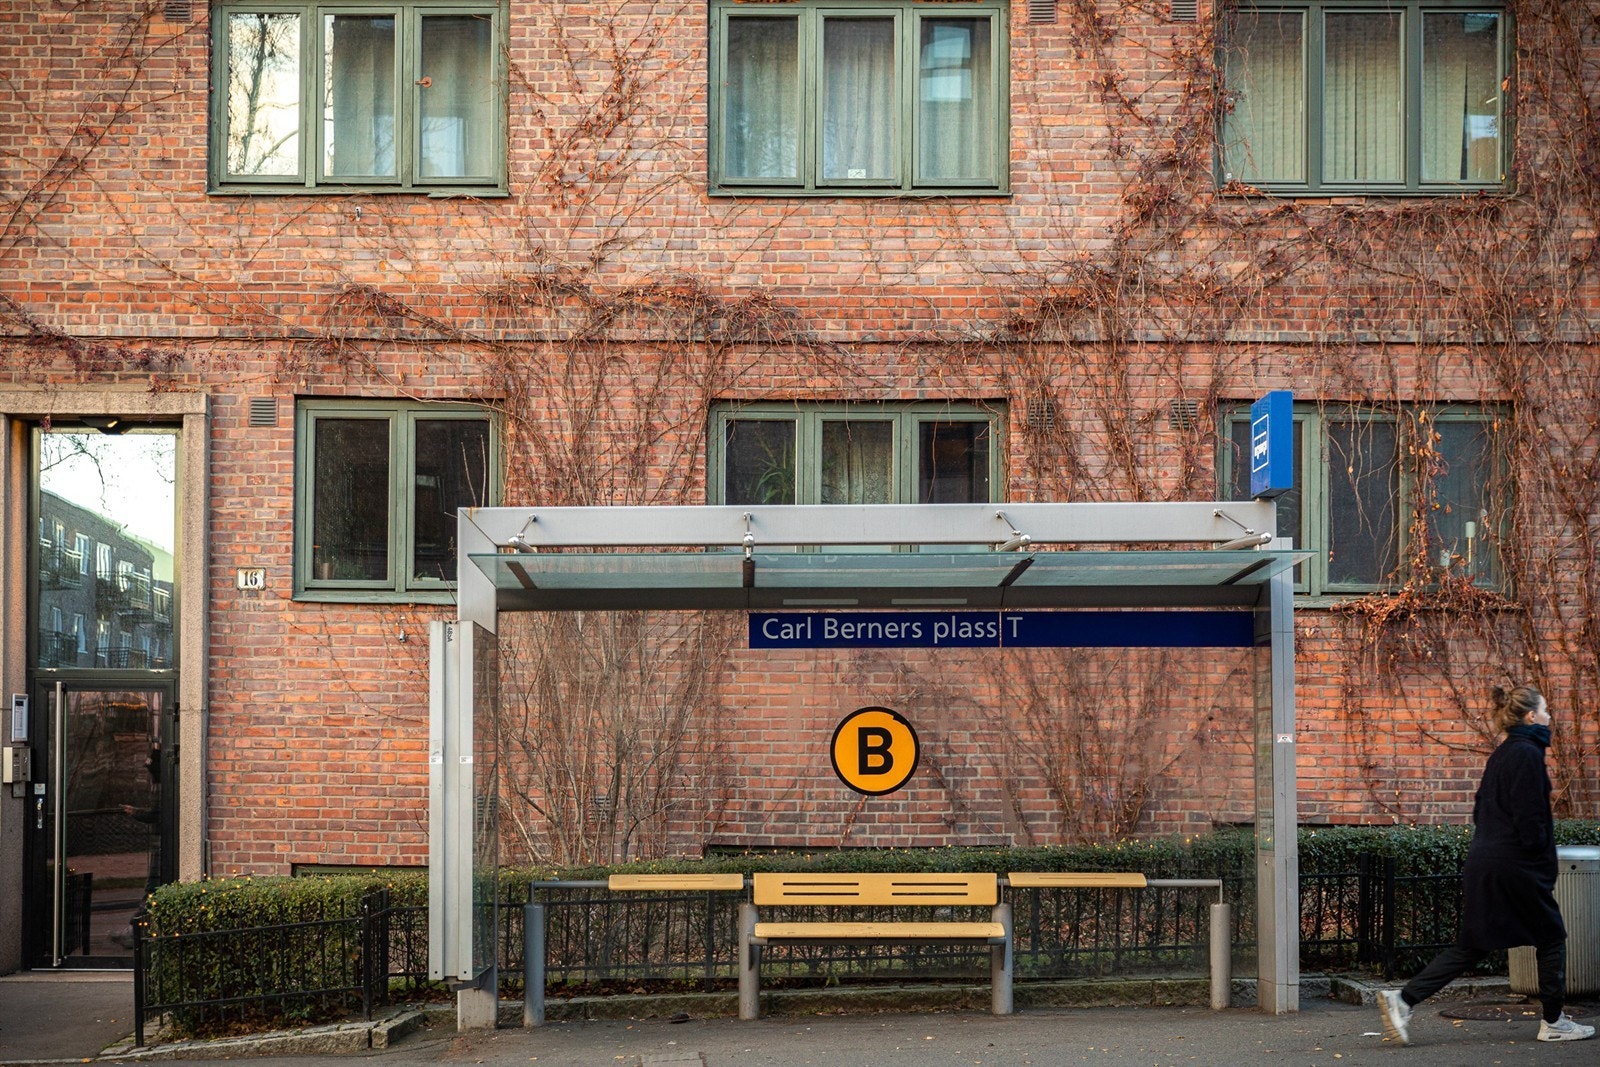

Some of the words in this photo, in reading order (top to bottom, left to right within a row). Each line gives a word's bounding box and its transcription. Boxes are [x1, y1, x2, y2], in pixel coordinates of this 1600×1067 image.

[244, 571, 258, 586] 16
[762, 616, 812, 640] Carl
[824, 617, 923, 639] Berners
[933, 615, 998, 644] plass
[1006, 616, 1024, 638] T
[857, 726, 894, 775] B
